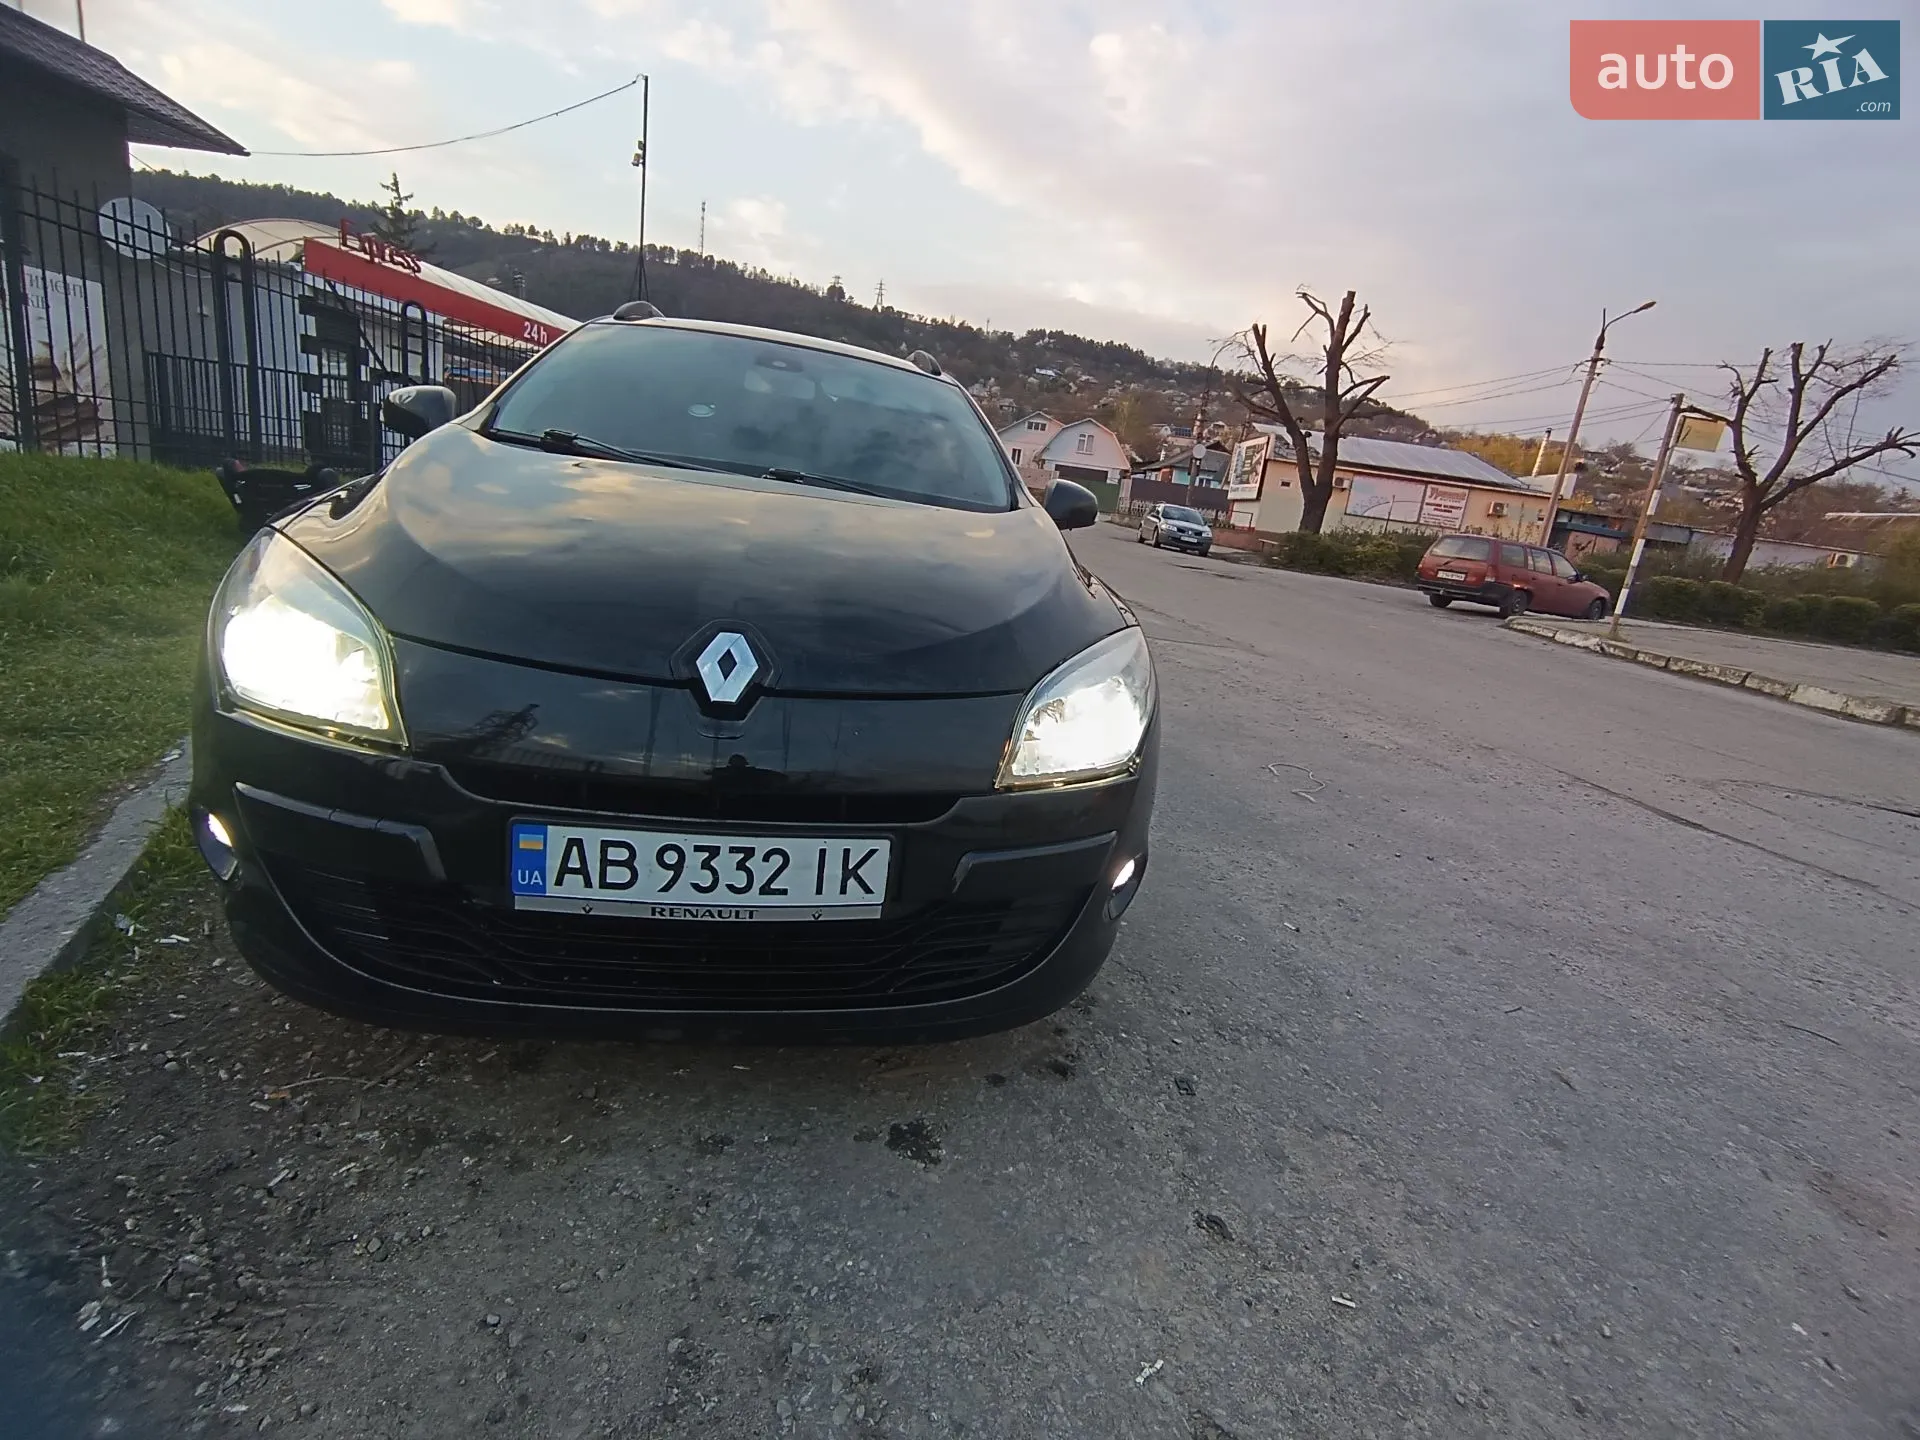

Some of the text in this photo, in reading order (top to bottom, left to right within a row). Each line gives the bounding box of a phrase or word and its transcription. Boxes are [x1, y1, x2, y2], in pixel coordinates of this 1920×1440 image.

[341, 218, 422, 274] Express
[517, 869, 543, 886] UA
[553, 837, 880, 897] AB 9332 IK
[650, 905, 759, 920] RENAULT
